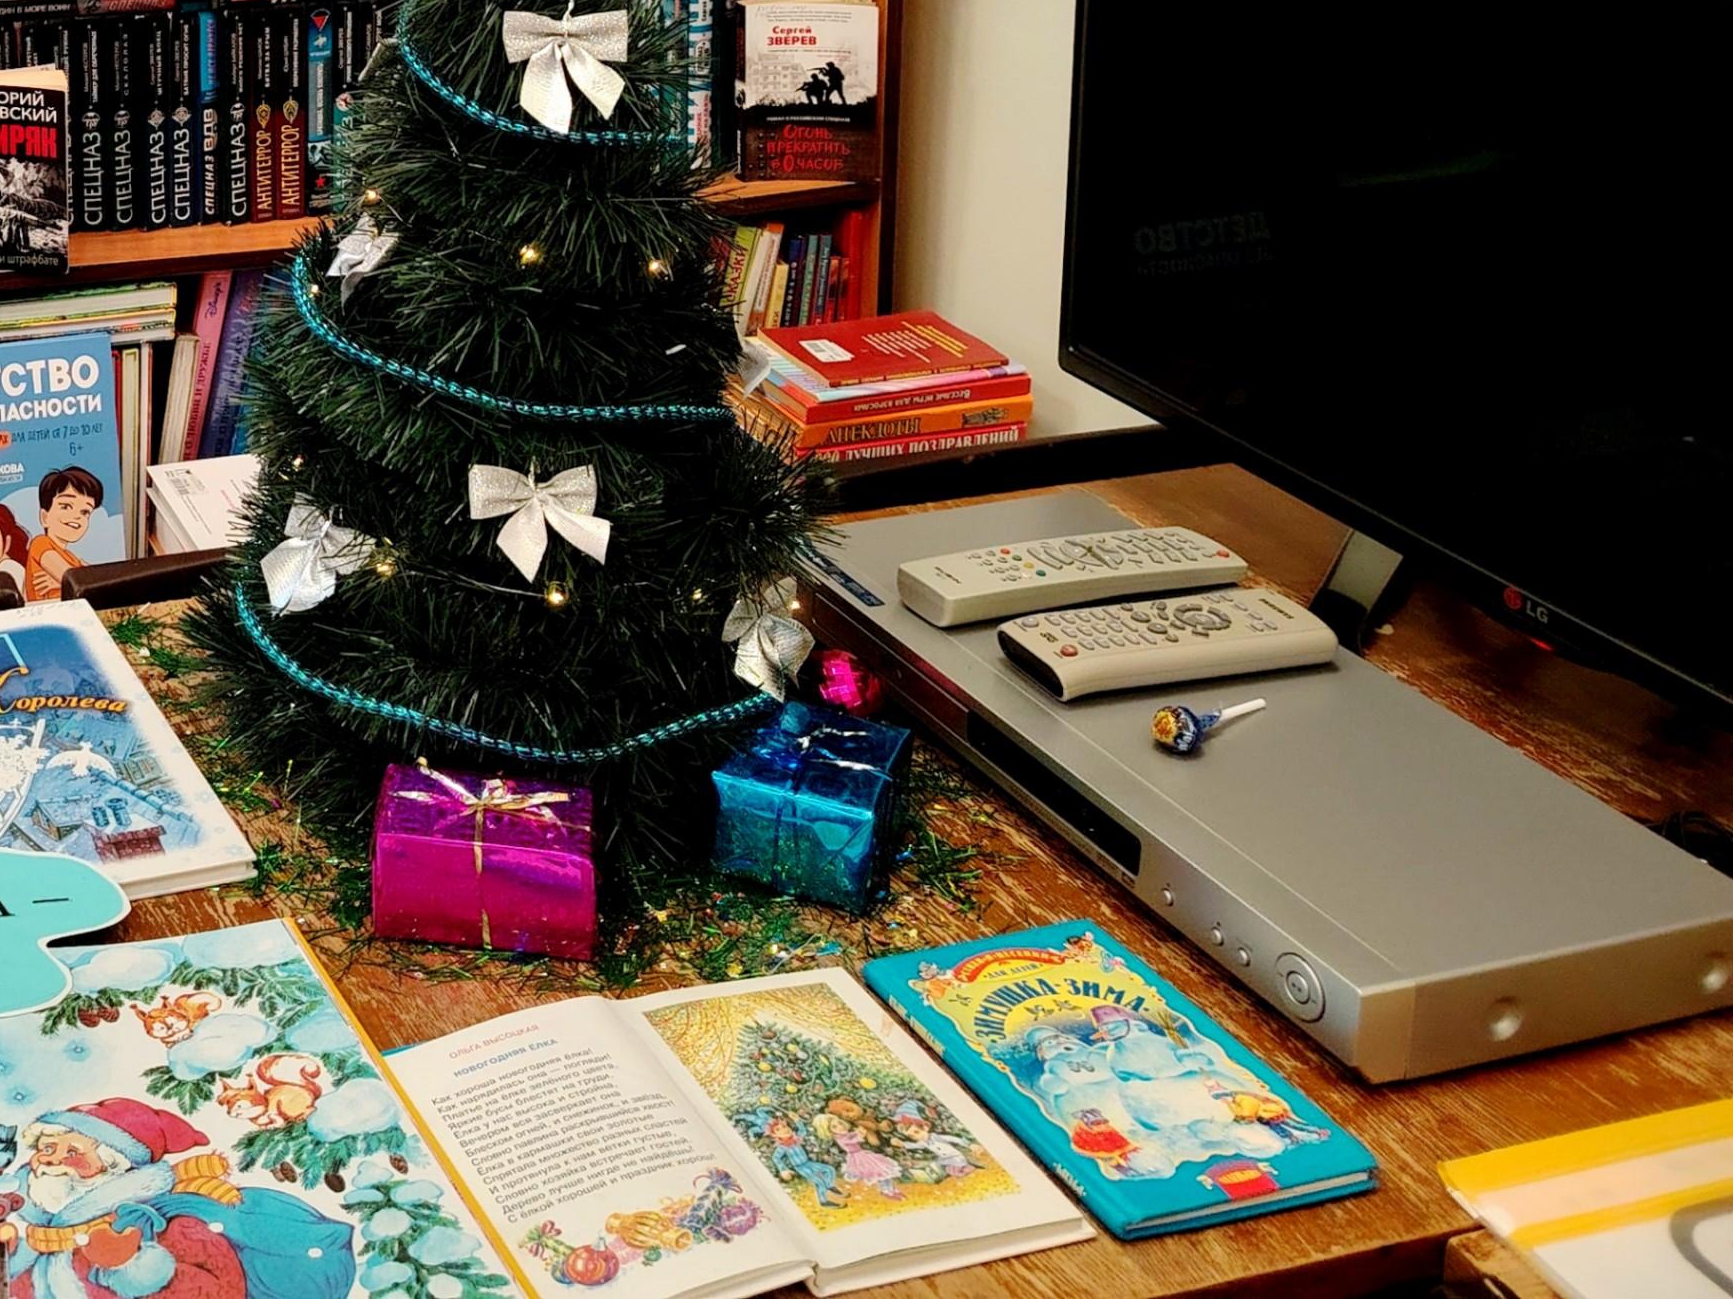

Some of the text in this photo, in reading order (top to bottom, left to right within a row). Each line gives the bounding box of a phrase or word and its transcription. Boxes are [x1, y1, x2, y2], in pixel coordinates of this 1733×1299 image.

[768, 35, 817, 46] ЗВЕРЕВ
[772, 26, 812, 35] Сергей
[172, 128, 192, 220] СПЕЦНАЗ
[7, 253, 59, 267] штрафбате
[824, 417, 921, 444] АНЕКДОТЫ
[909, 426, 1019, 453] ПОЗДРАВЛЕНИЙ
[1526, 600, 1548, 624] LG
[448, 1024, 540, 1060] ОЛЬГА ВЫСОЦКАЯ
[454, 1047, 527, 1078] НОВОГОДНЯЯ
